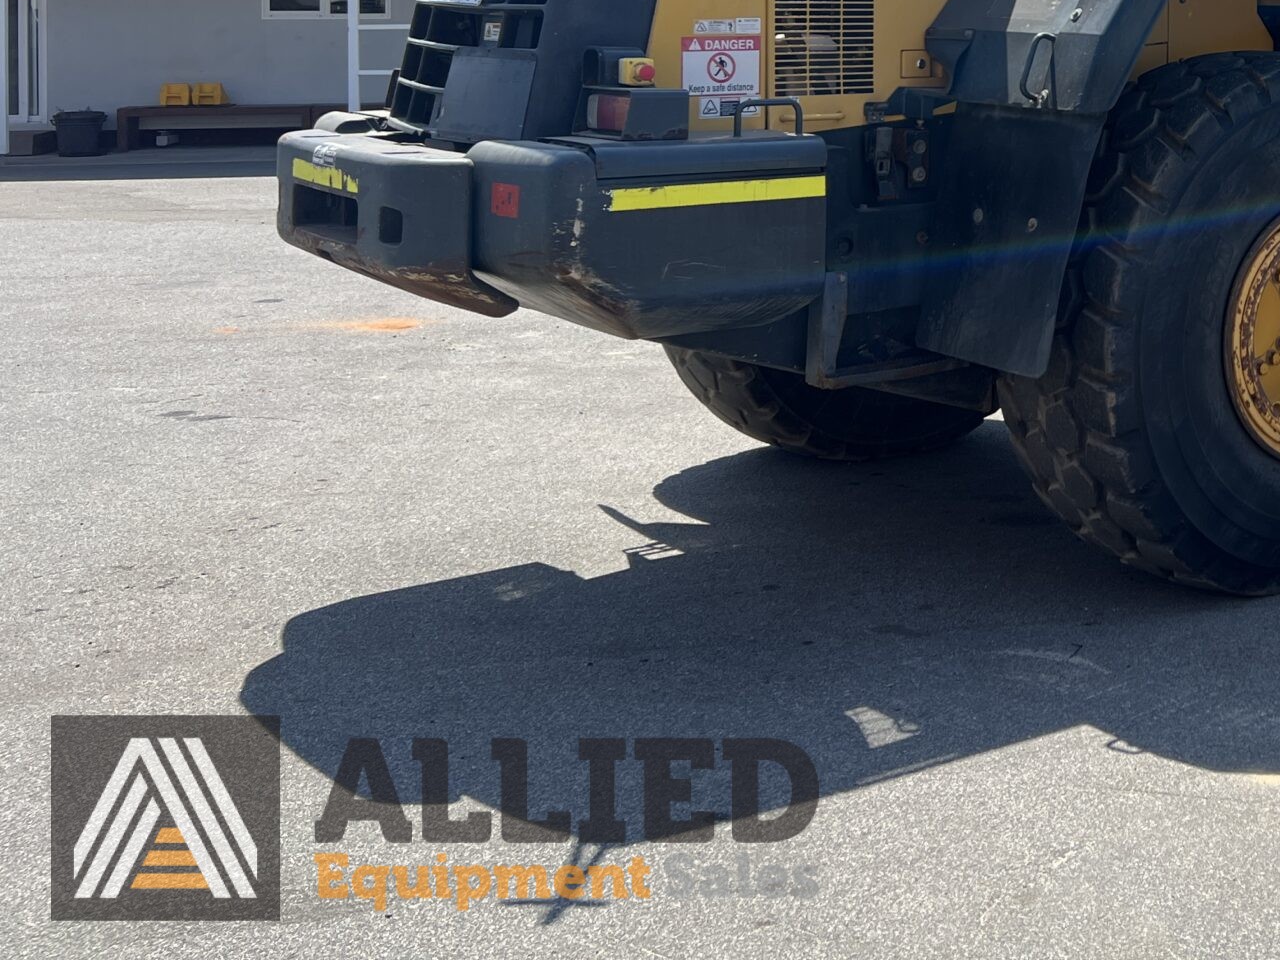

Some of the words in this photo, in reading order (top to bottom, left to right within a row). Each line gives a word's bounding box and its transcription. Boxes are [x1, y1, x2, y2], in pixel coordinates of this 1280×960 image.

[704, 39, 754, 50] DANGER
[688, 84, 705, 93] Keep
[712, 84, 726, 92] safe
[727, 83, 754, 92] distance
